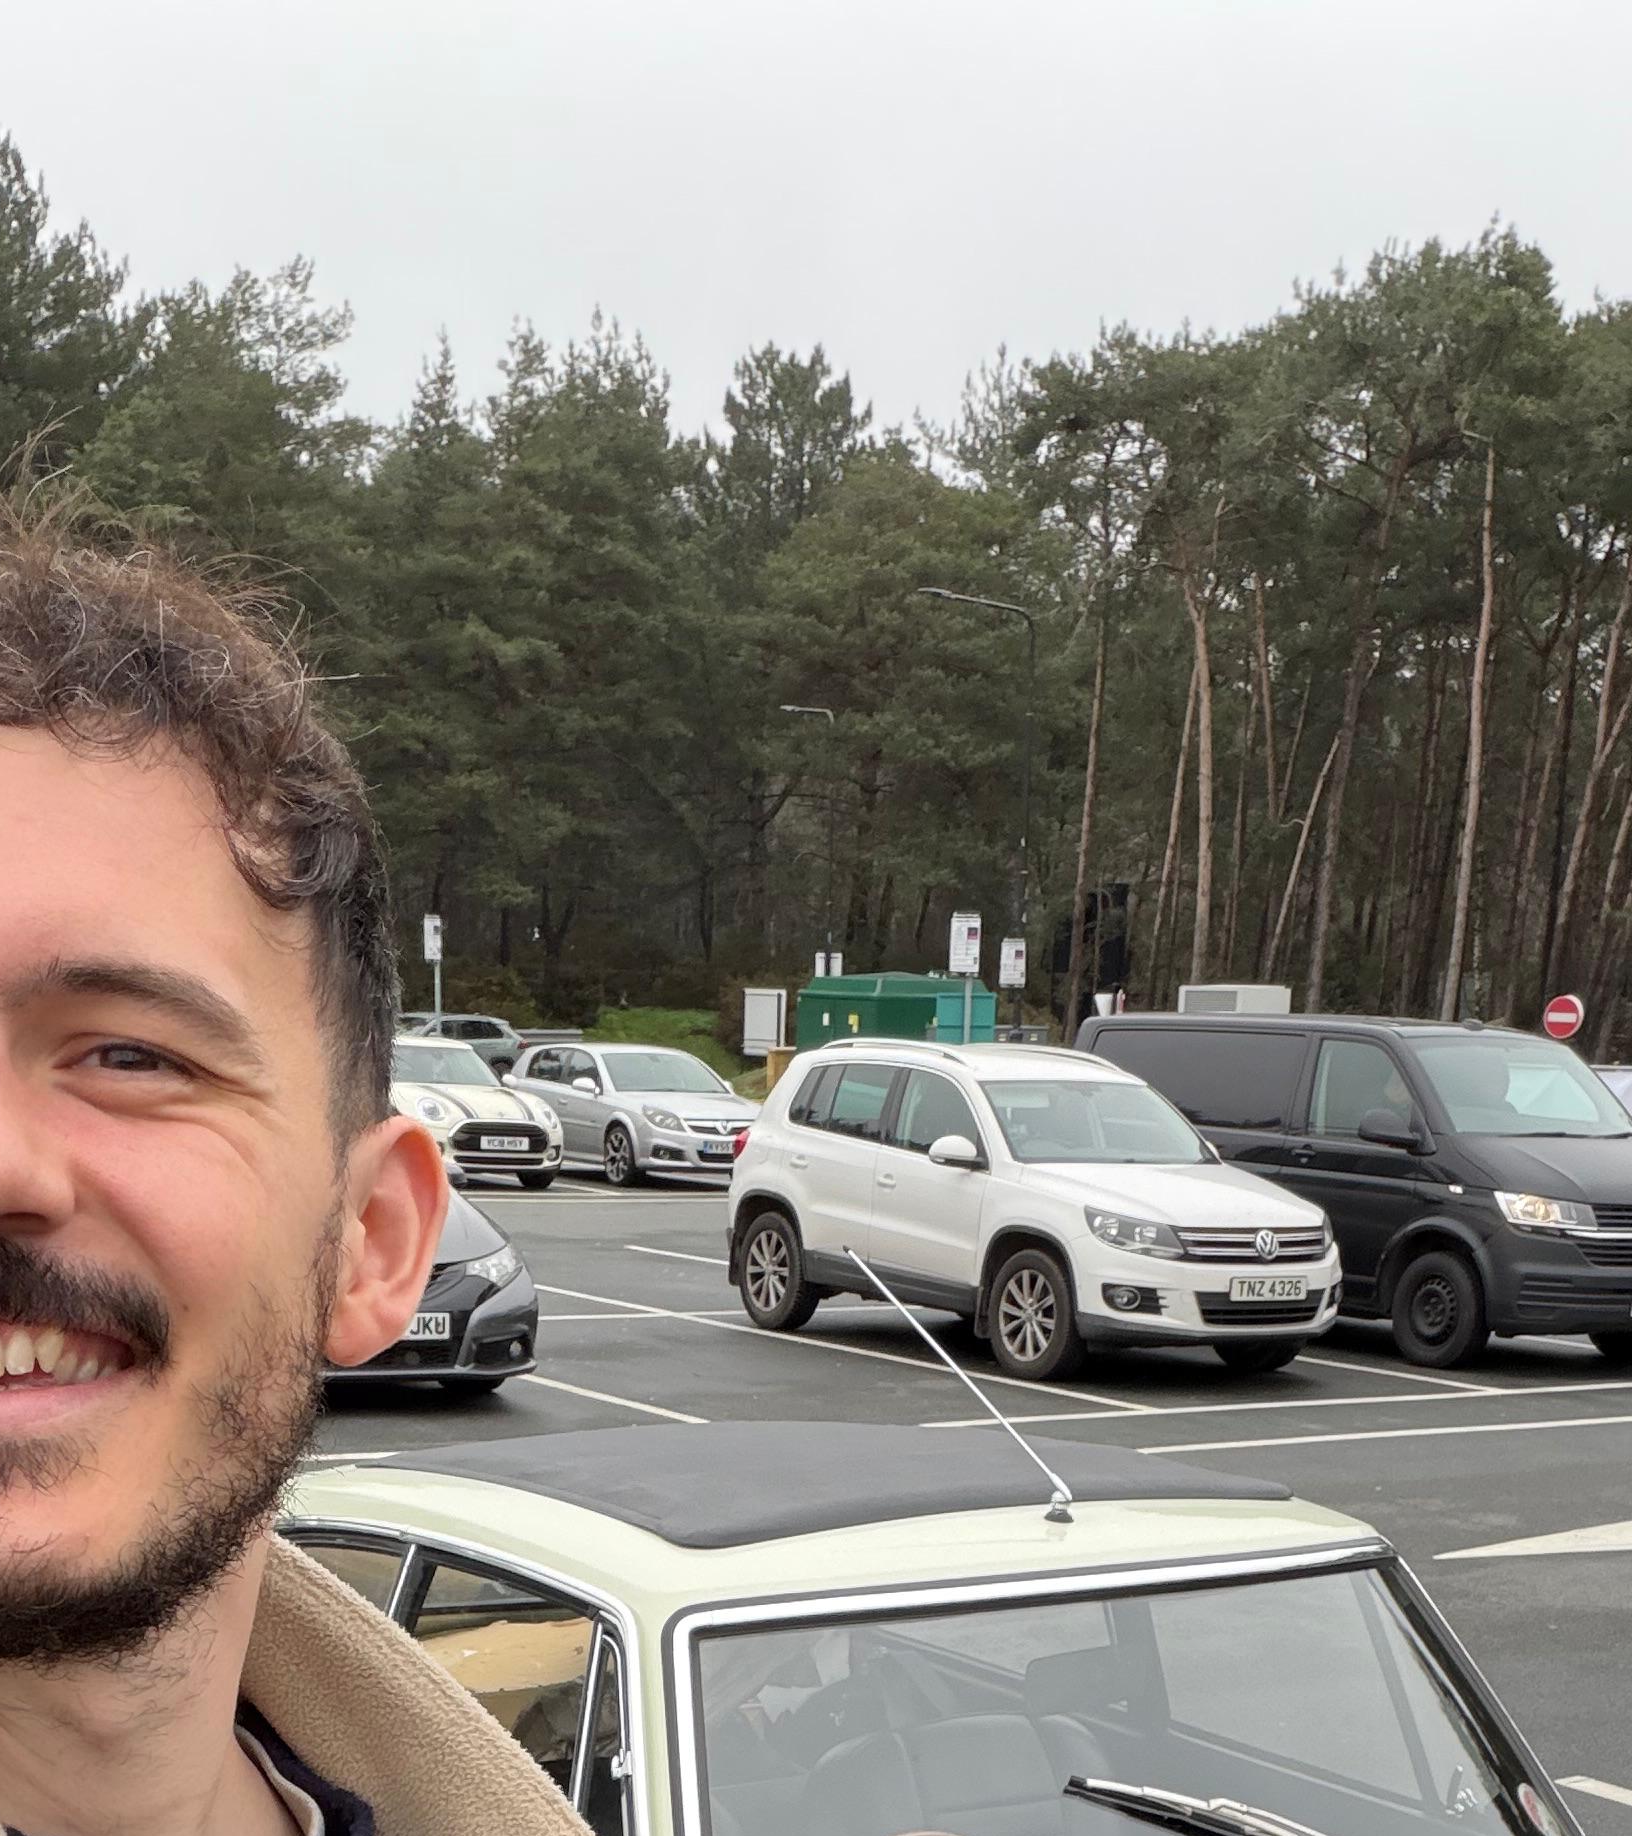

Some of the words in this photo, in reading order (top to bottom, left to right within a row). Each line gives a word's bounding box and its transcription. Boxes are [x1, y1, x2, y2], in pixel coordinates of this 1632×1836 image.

[1237, 1280, 1266, 1298] TNZ
[1268, 1279, 1302, 1297] 4326
[409, 1315, 446, 1335] JKU
